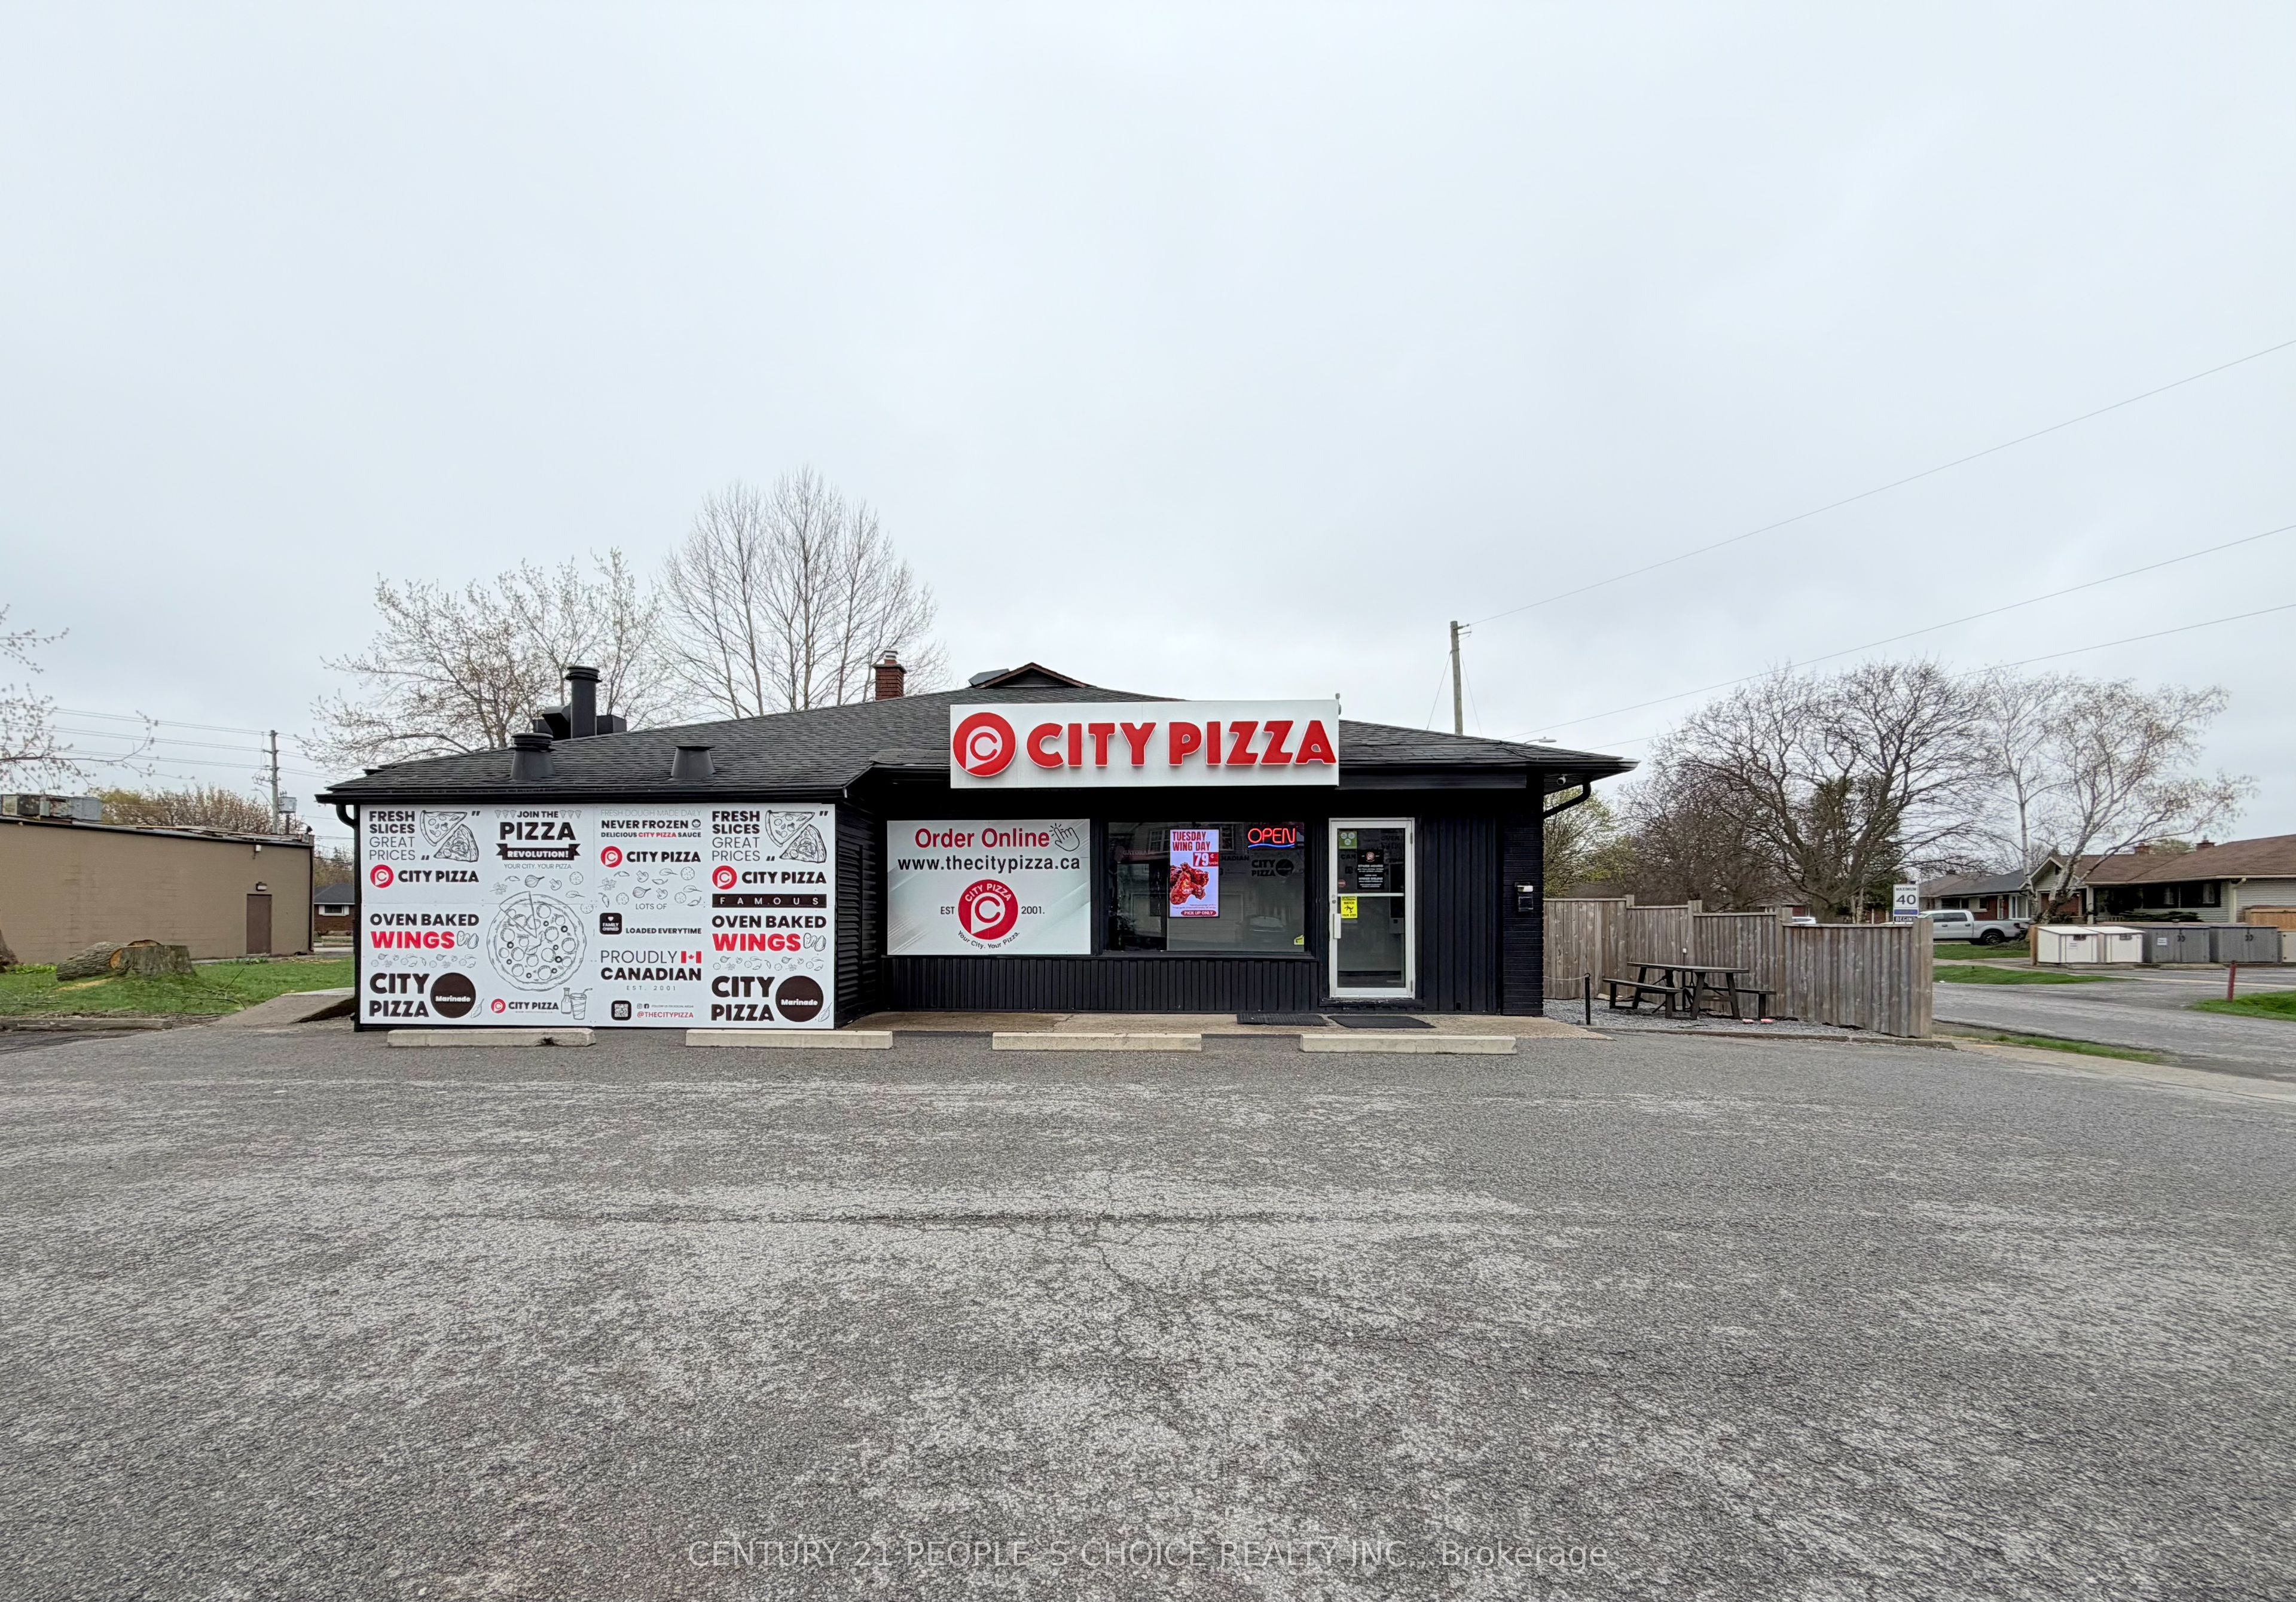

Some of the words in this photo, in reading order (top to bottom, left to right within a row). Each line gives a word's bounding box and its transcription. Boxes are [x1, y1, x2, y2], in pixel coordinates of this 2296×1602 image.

[1027, 722, 1157, 768] CITY
[1168, 720, 1337, 766] PIZZA
[370, 811, 415, 822] FRESH
[712, 811, 760, 822] FRESH
[370, 824, 415, 834] SLICES
[602, 820, 640, 829] NEVER
[642, 820, 688, 829] FROZEN
[712, 824, 760, 834] SLICES
[500, 822, 576, 840] PIZZA
[1173, 831, 1206, 841] TUESDAY
[1247, 828, 1296, 844] OPEN
[370, 837, 416, 847] GREAT
[712, 837, 760, 849] GREAT
[915, 828, 975, 848] Order
[981, 828, 1050, 848] Online
[1173, 841, 1193, 852] WING
[1195, 841, 1211, 852] DAY
[370, 850, 416, 860] PRICES
[627, 851, 658, 863] CITY
[661, 852, 701, 863] PIZZA
[712, 850, 761, 862] PRICES
[897, 855, 1080, 874] www.thecitypizza.ca
[1251, 859, 1276, 868] CITY
[398, 870, 432, 882] CITY
[435, 871, 480, 882] PIZZA
[741, 871, 778, 884] CITY
[781, 871, 827, 884] PIZZA
[964, 884, 983, 902] CITY
[987, 883, 1012, 901] PIZZA
[1896, 895, 1916, 905] 40
[941, 906, 955, 914] EST
[1021, 906, 1045, 914] 2001.
[370, 914, 417, 926] OVEN
[421, 914, 480, 926] BAKED
[712, 915, 761, 928] OVEN
[765, 916, 826, 929] BAKED
[370, 931, 455, 949] WINGS
[712, 933, 801, 951] WINGS
[958, 930, 970, 943] Your
[971, 940, 986, 950] City.
[1003, 932, 1020, 945] Pizza.
[600, 950, 677, 964] PROUDLY
[600, 967, 701, 981] CANADIAN
[370, 972, 430, 994] CITY
[712, 975, 775, 997] CITY
[369, 1000, 429, 1017] PIZZA
[711, 1004, 775, 1021] PIZZA
